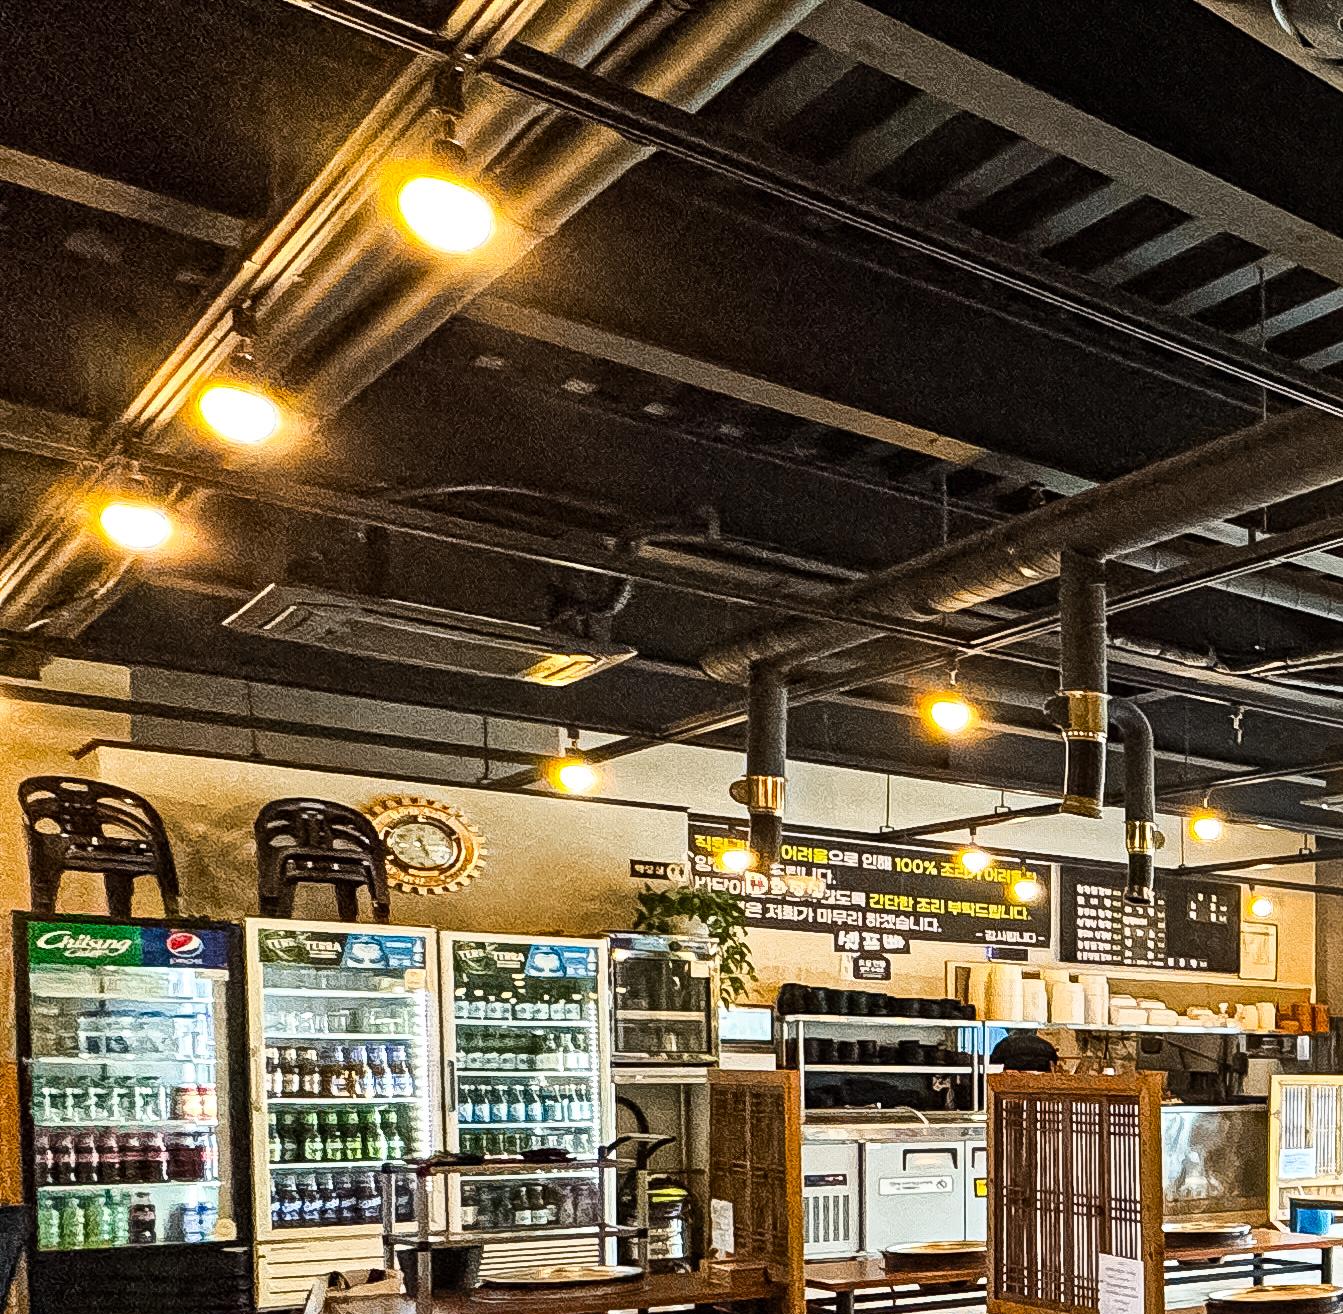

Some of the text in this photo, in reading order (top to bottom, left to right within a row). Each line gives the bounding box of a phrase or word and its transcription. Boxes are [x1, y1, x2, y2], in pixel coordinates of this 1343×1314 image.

[895, 858, 938, 875] 100%
[869, 893, 914, 911] 간단한
[916, 898, 945, 915] 조리
[865, 912, 942, 932] 하겠습니다.
